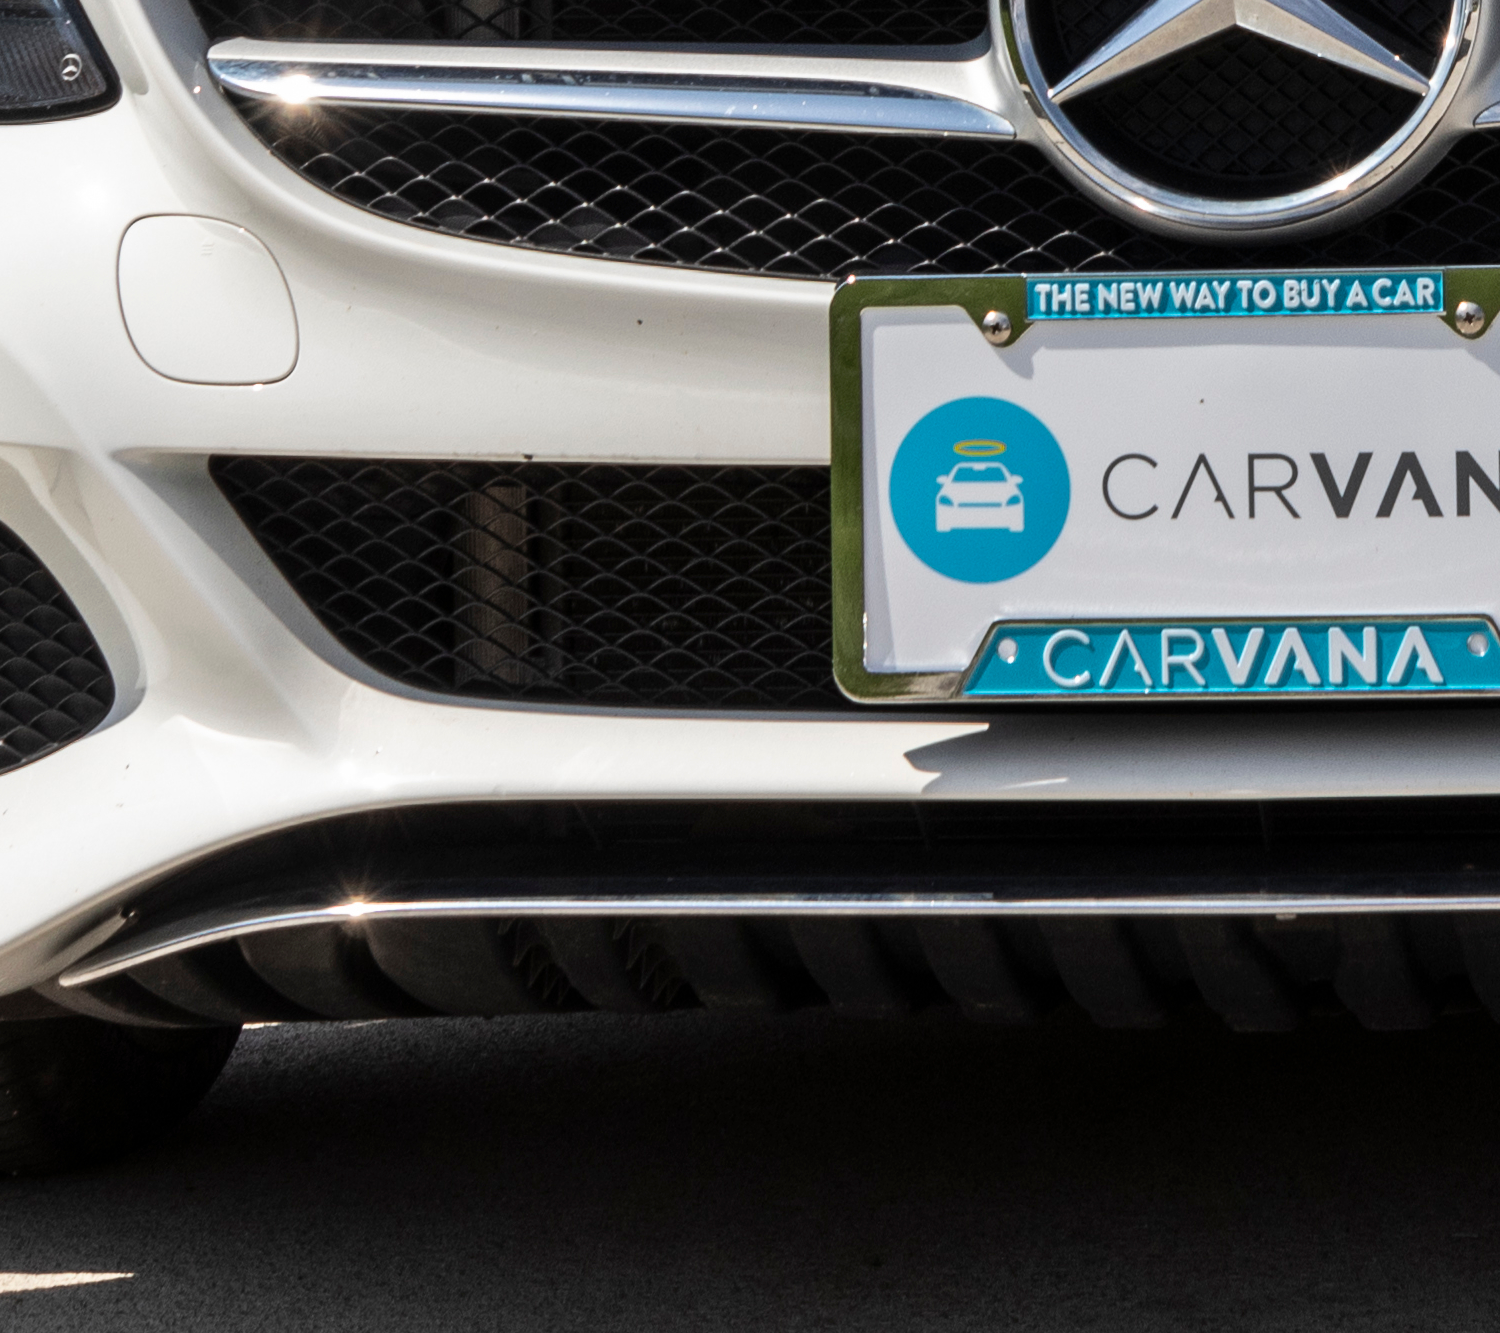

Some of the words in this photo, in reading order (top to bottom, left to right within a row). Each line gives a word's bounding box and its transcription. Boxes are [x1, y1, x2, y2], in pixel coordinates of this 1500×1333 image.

[1034, 283, 1090, 312] THE
[1099, 281, 1163, 311] NEW
[1169, 280, 1230, 310] WAY
[1237, 280, 1277, 309] TO
[1283, 278, 1340, 309] BUY
[1346, 279, 1369, 308] A
[1372, 277, 1435, 307] CAR
[1042, 624, 1445, 690] CARVANA
